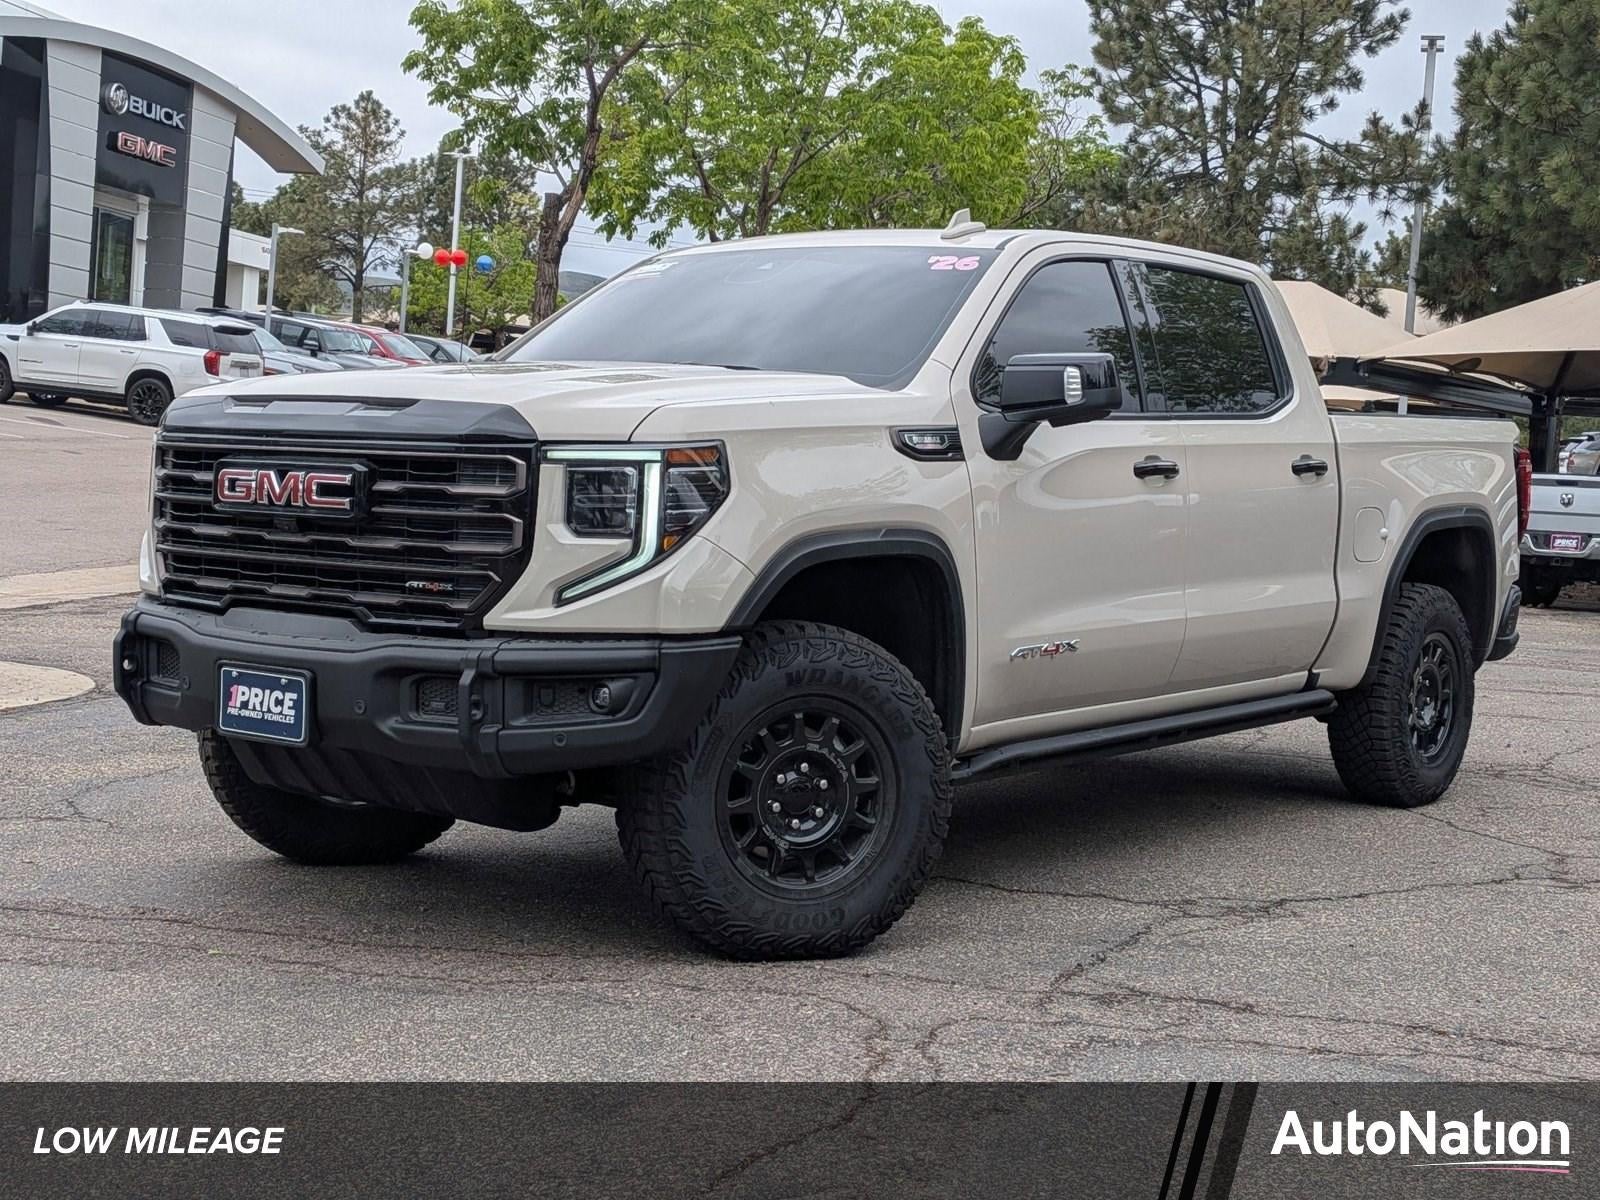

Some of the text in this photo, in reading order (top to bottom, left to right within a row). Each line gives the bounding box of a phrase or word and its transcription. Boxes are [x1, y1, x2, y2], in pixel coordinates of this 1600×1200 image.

[129, 95, 185, 129] BUICK
[117, 131, 176, 168] GMC
[217, 468, 352, 509] GMC
[226, 706, 294, 724] PRE-OWNED VEHICLES
